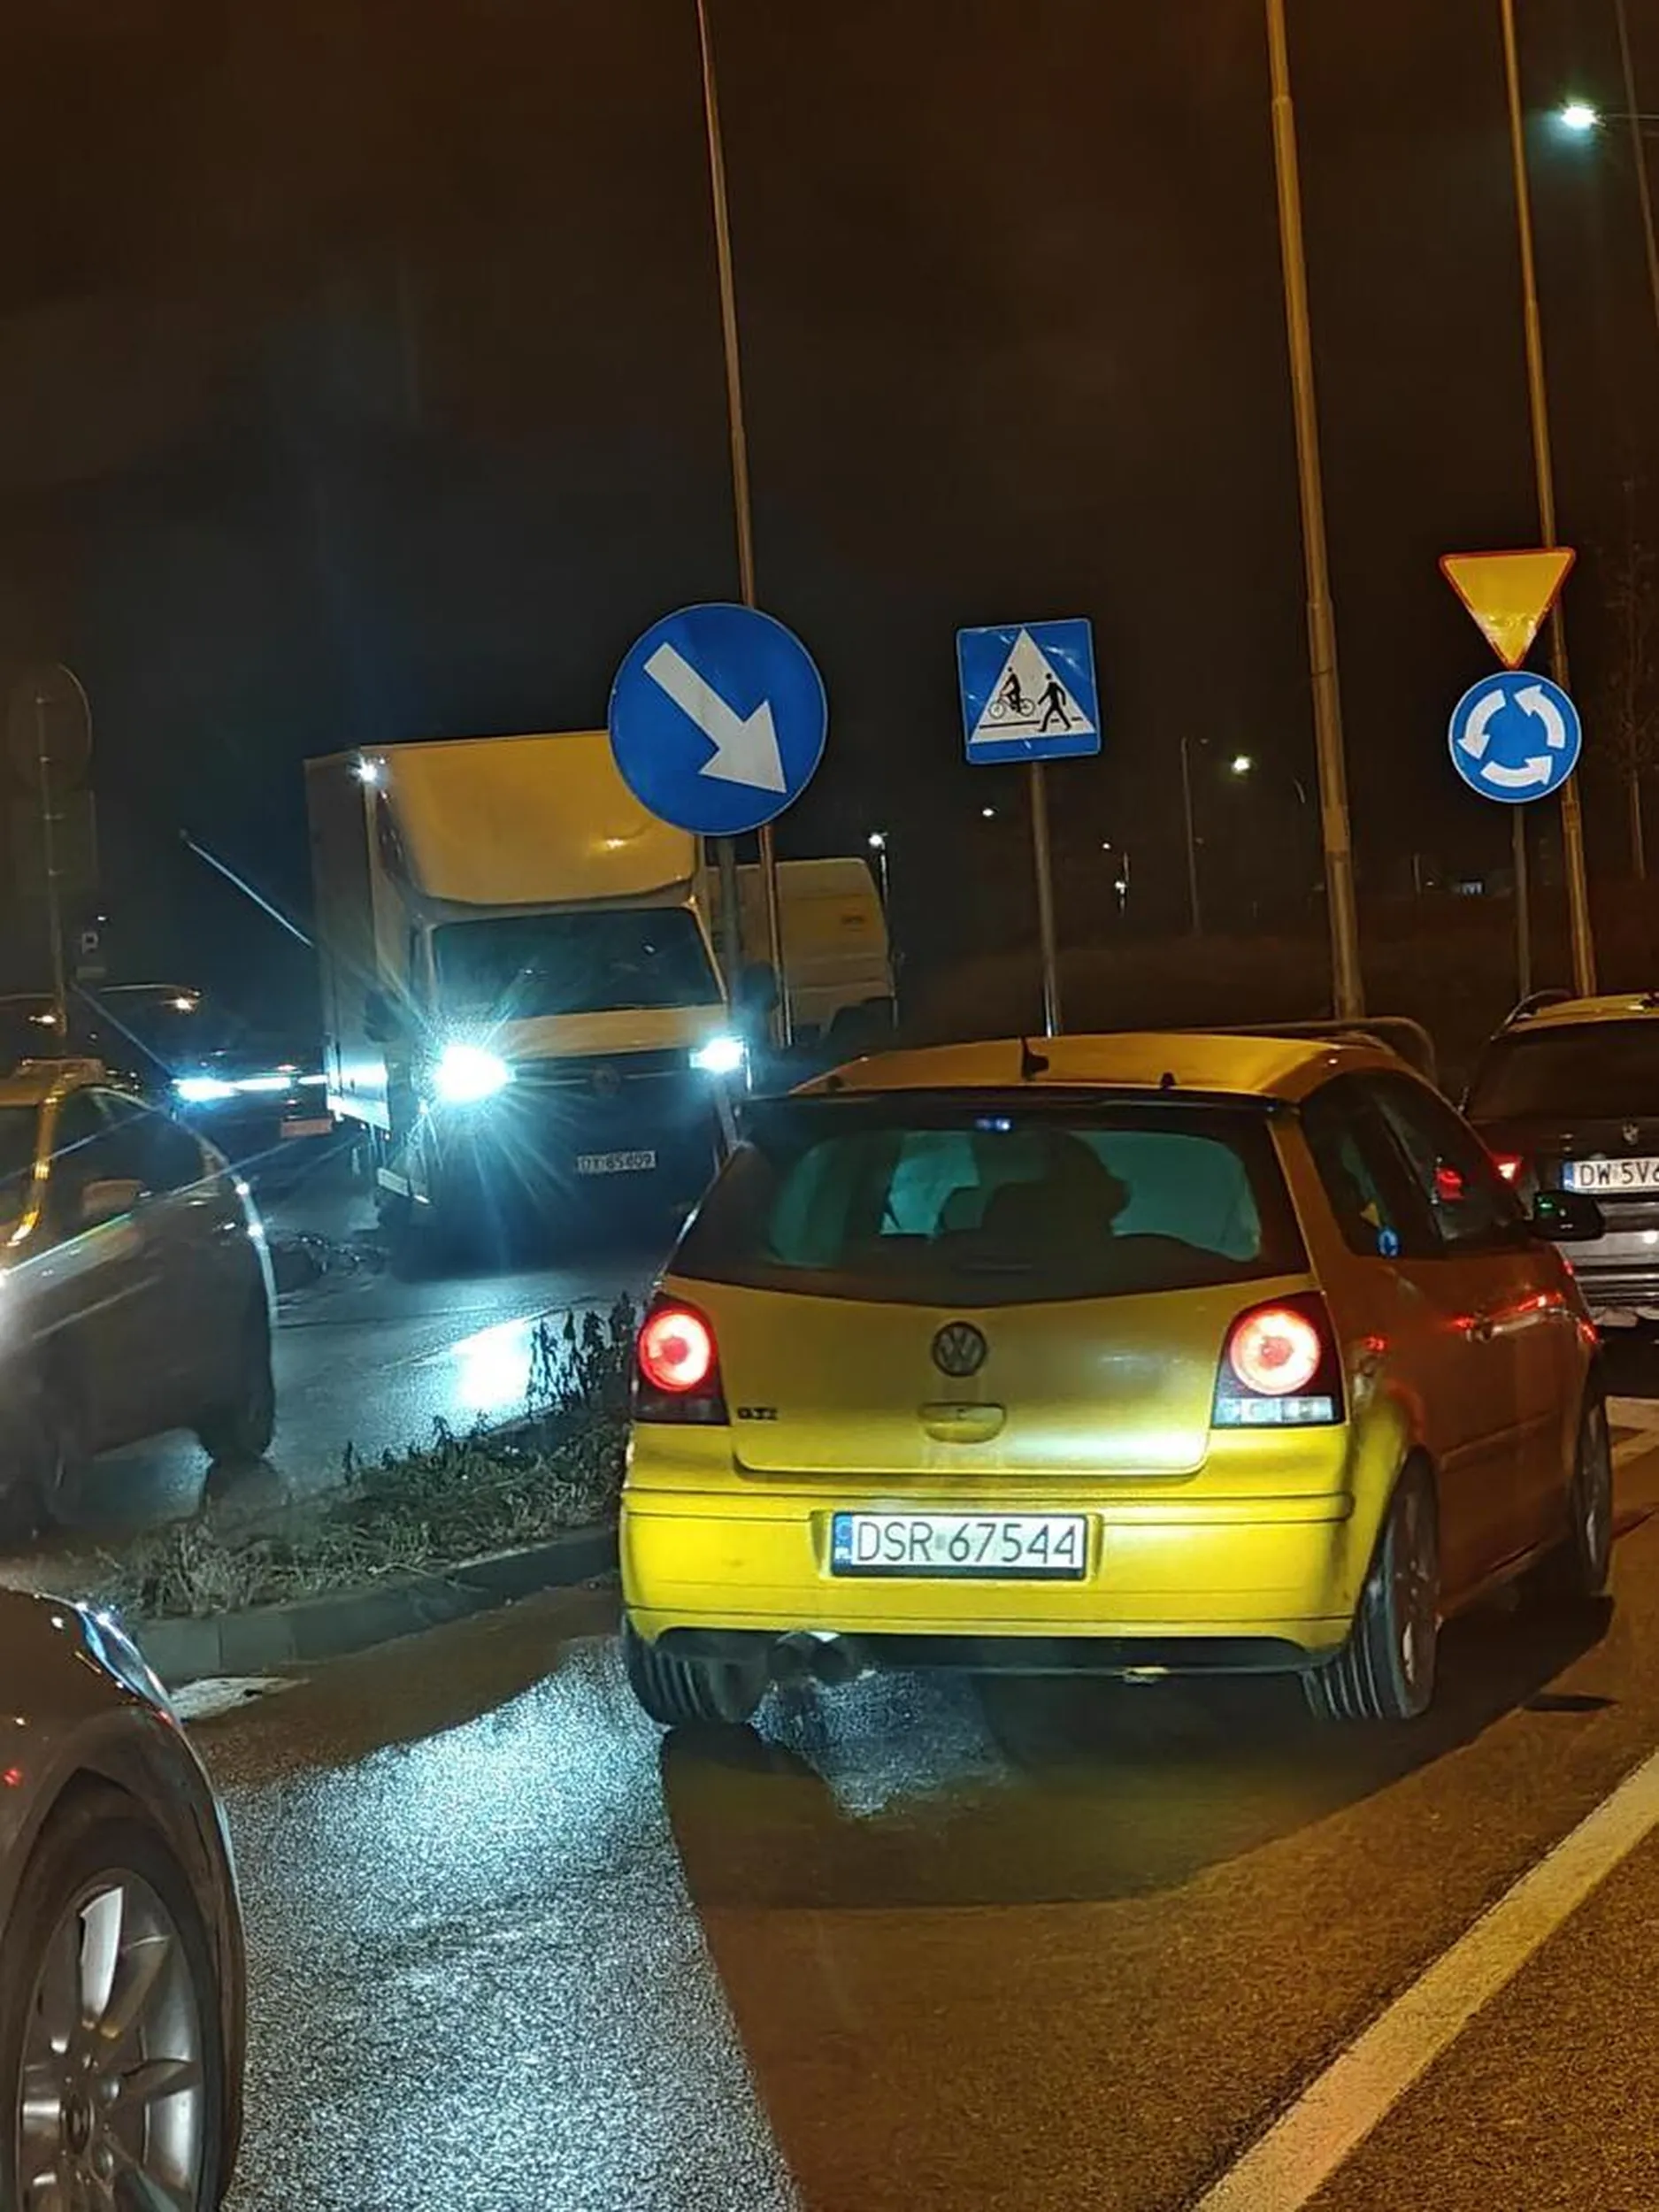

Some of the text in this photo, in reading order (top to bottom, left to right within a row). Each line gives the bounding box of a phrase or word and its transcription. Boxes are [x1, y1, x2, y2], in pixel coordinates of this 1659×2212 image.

[1579, 1163, 1611, 1186] DW
[857, 1521, 1076, 1564] DSR 67544
